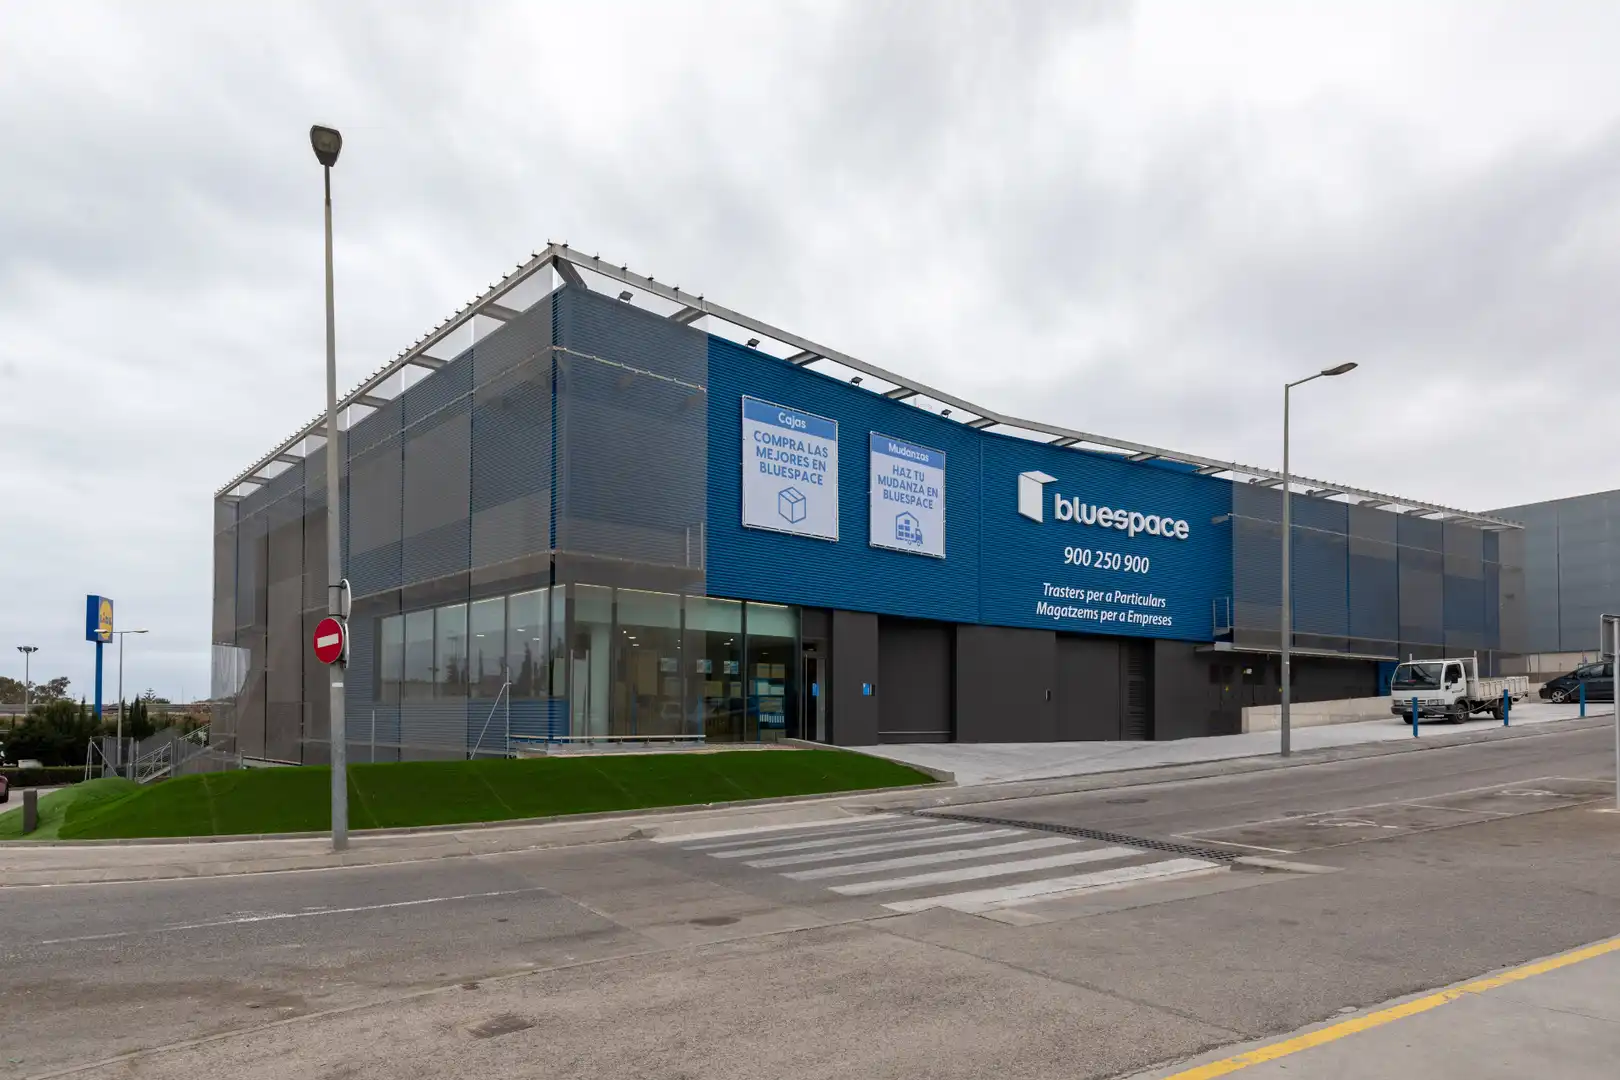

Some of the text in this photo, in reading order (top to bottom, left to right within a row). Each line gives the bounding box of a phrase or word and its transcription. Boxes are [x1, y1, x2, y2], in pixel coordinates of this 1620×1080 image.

[778, 412, 806, 429] Cajas
[754, 430, 828, 458] COMPRA LAS
[888, 443, 929, 462] Mudanzas
[756, 446, 826, 472] MEJORES EN
[760, 461, 823, 486] BLUESPACE
[892, 465, 924, 482] HAZ TU
[878, 475, 938, 498] MUDANZA EN
[884, 489, 933, 510] BLUESPACE
[1054, 493, 1190, 540] bluespace
[1064, 546, 1150, 574] 900 250 900
[1044, 582, 1166, 608] Trasters per a Particulars
[1036, 602, 1172, 626] Magatzems per a Empreses
